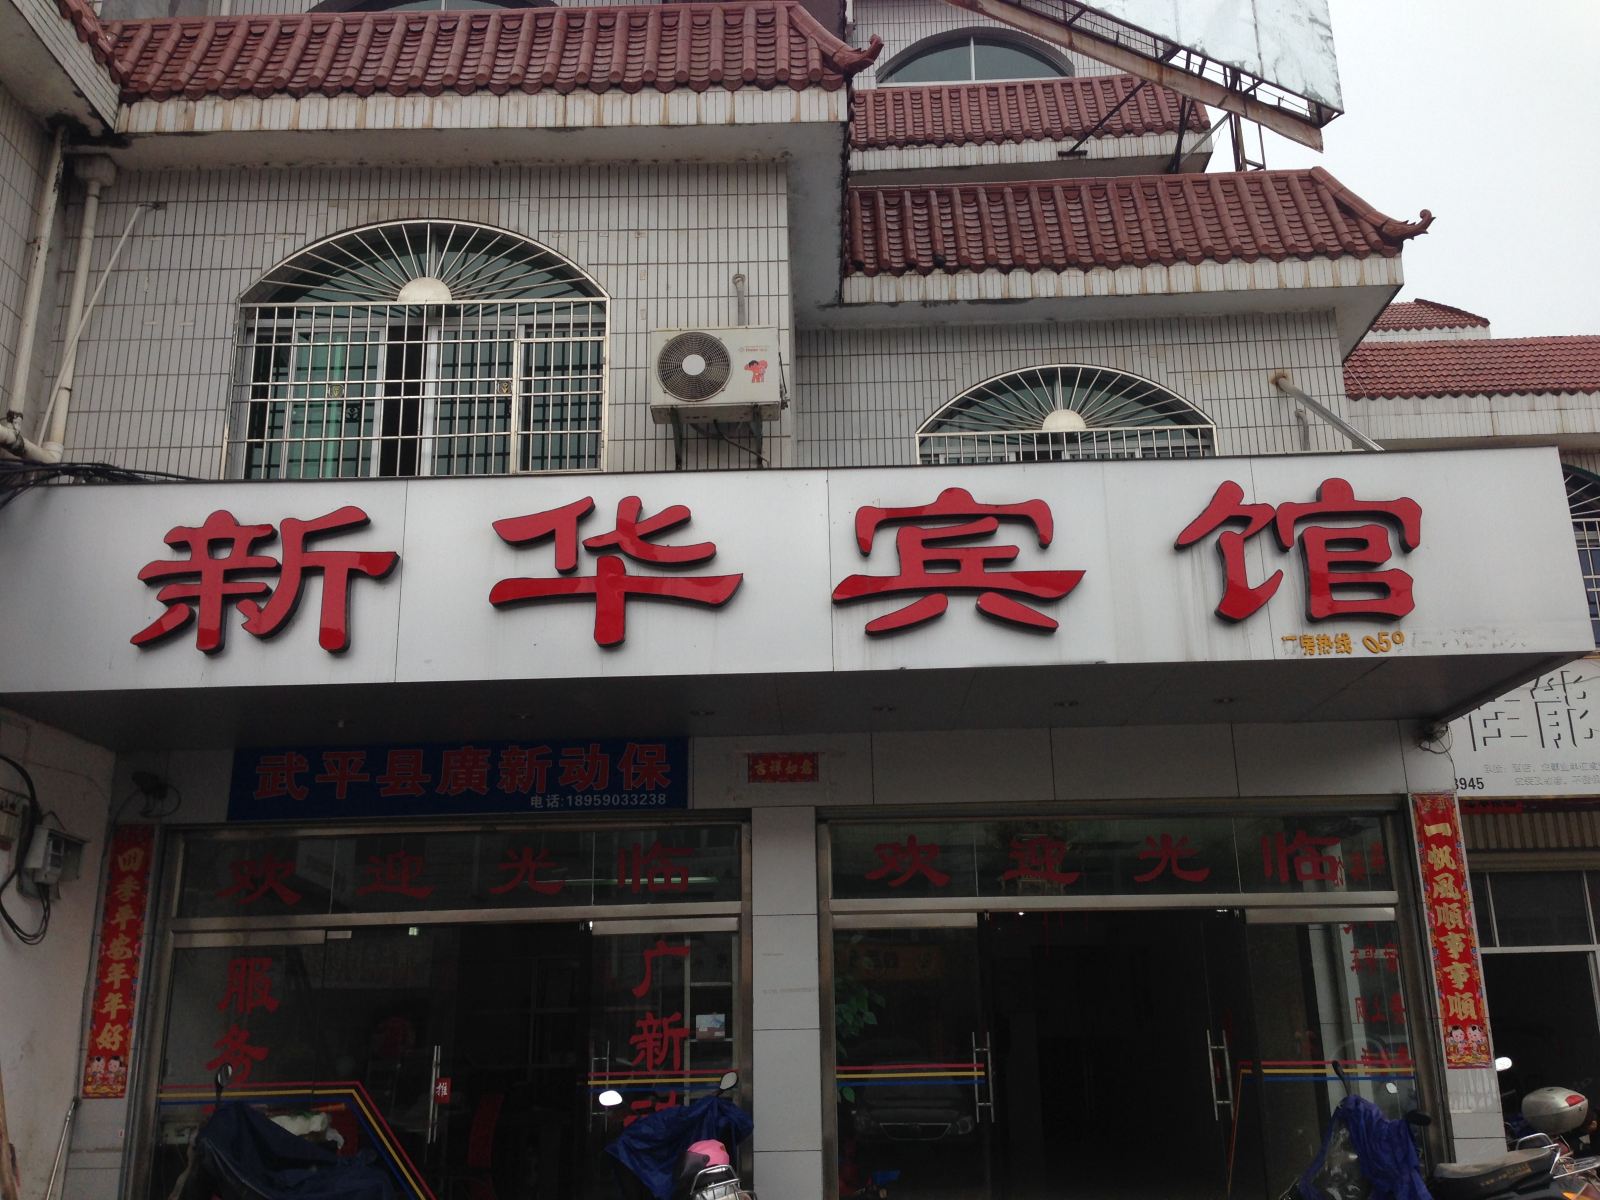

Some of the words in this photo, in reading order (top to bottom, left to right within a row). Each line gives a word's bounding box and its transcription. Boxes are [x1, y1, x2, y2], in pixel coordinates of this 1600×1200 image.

[132, 478, 1422, 657] 新华宾馆
[1281, 632, 1353, 656] 房热线
[253, 743, 671, 801] 武平县廣新动保
[215, 842, 693, 905] 欢迎光临
[865, 831, 1343, 886] 欢迎光临
[96, 847, 147, 1052] 四季平安年年好
